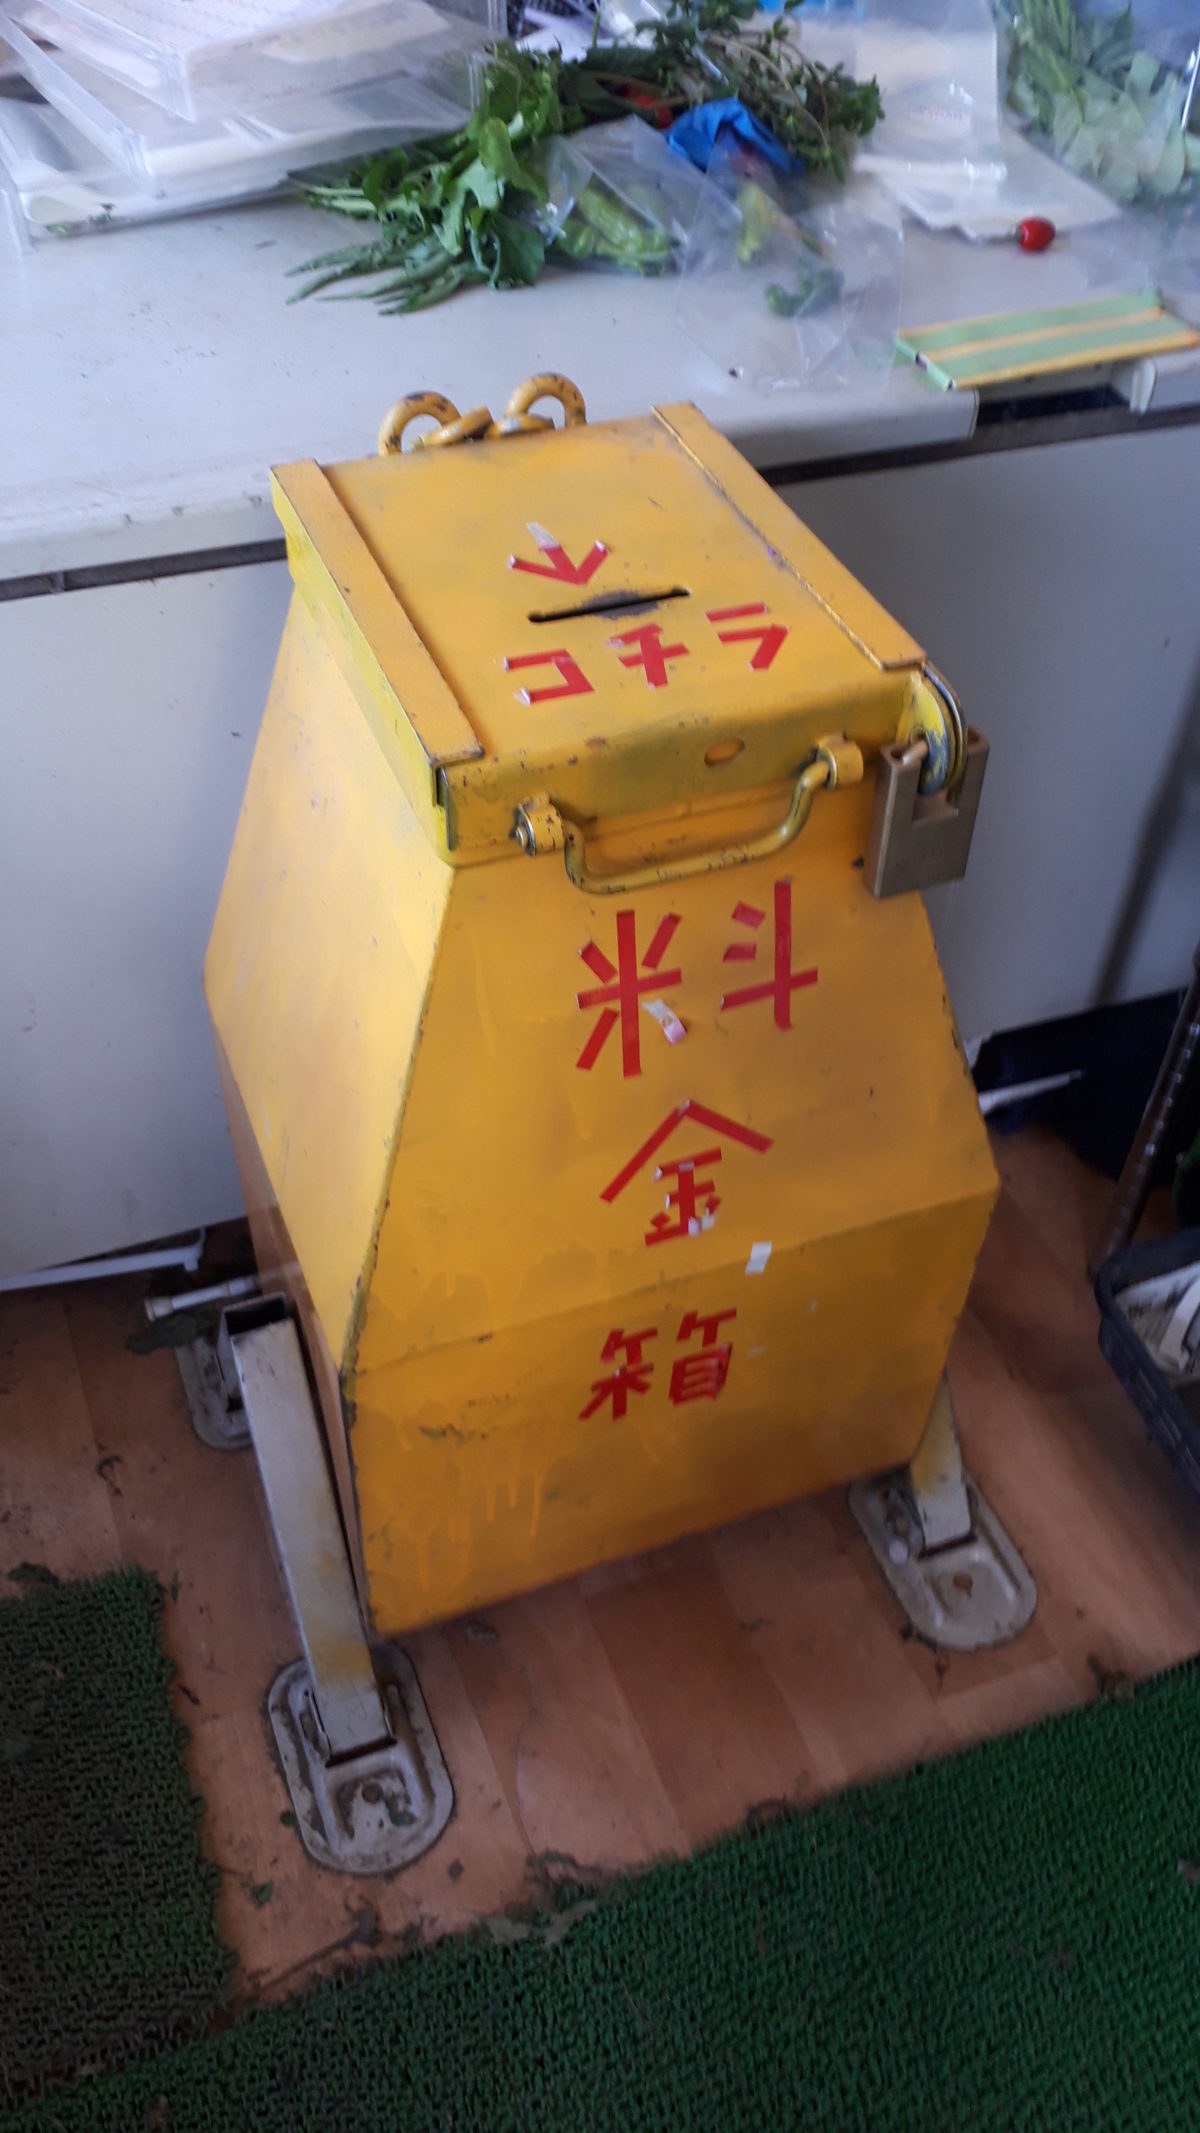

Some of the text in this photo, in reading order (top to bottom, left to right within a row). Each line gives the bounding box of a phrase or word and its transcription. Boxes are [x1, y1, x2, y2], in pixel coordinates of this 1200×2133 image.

[504, 602, 789, 703] コチラ
[576, 880, 818, 1421] 料金箱
